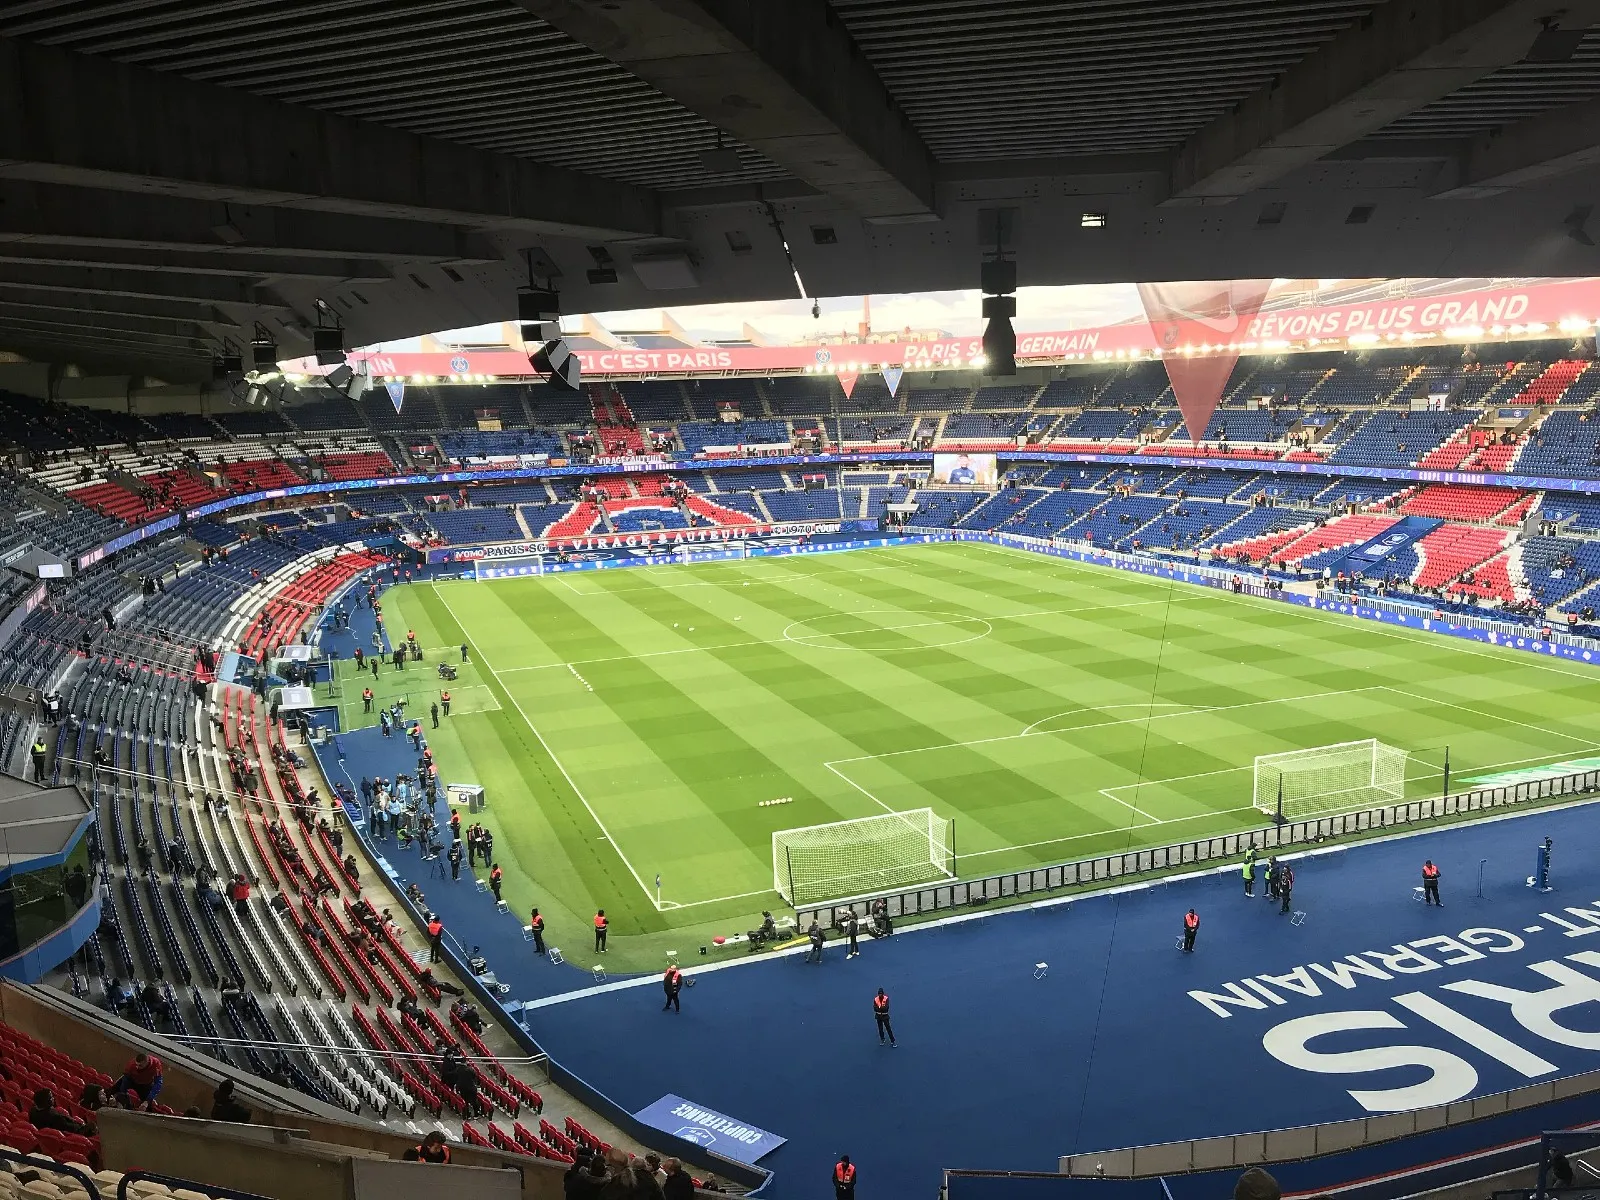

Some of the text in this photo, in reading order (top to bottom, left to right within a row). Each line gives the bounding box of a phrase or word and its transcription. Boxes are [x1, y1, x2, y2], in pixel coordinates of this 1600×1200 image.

[1244, 294, 1529, 338] RÊVONS PLUS GRAND
[904, 342, 961, 359] PARIS
[600, 353, 662, 370] C'EST
[667, 352, 732, 368] PARIS
[419, 446, 426, 454] U
[1418, 471, 1485, 484] COUPE DE FRANCE
[589, 487, 598, 495] A
[486, 545, 525, 557] PARIS
[529, 543, 546, 553] SG
[785, 524, 812, 535] 1970
[572, 528, 750, 550] VIRAGE AUTEUIL
[1250, 585, 1272, 599] FRANCE
[1262, 950, 1600, 1112] RIS
[670, 1103, 721, 1127] FRANCE
[718, 1121, 763, 1144] COUPE
